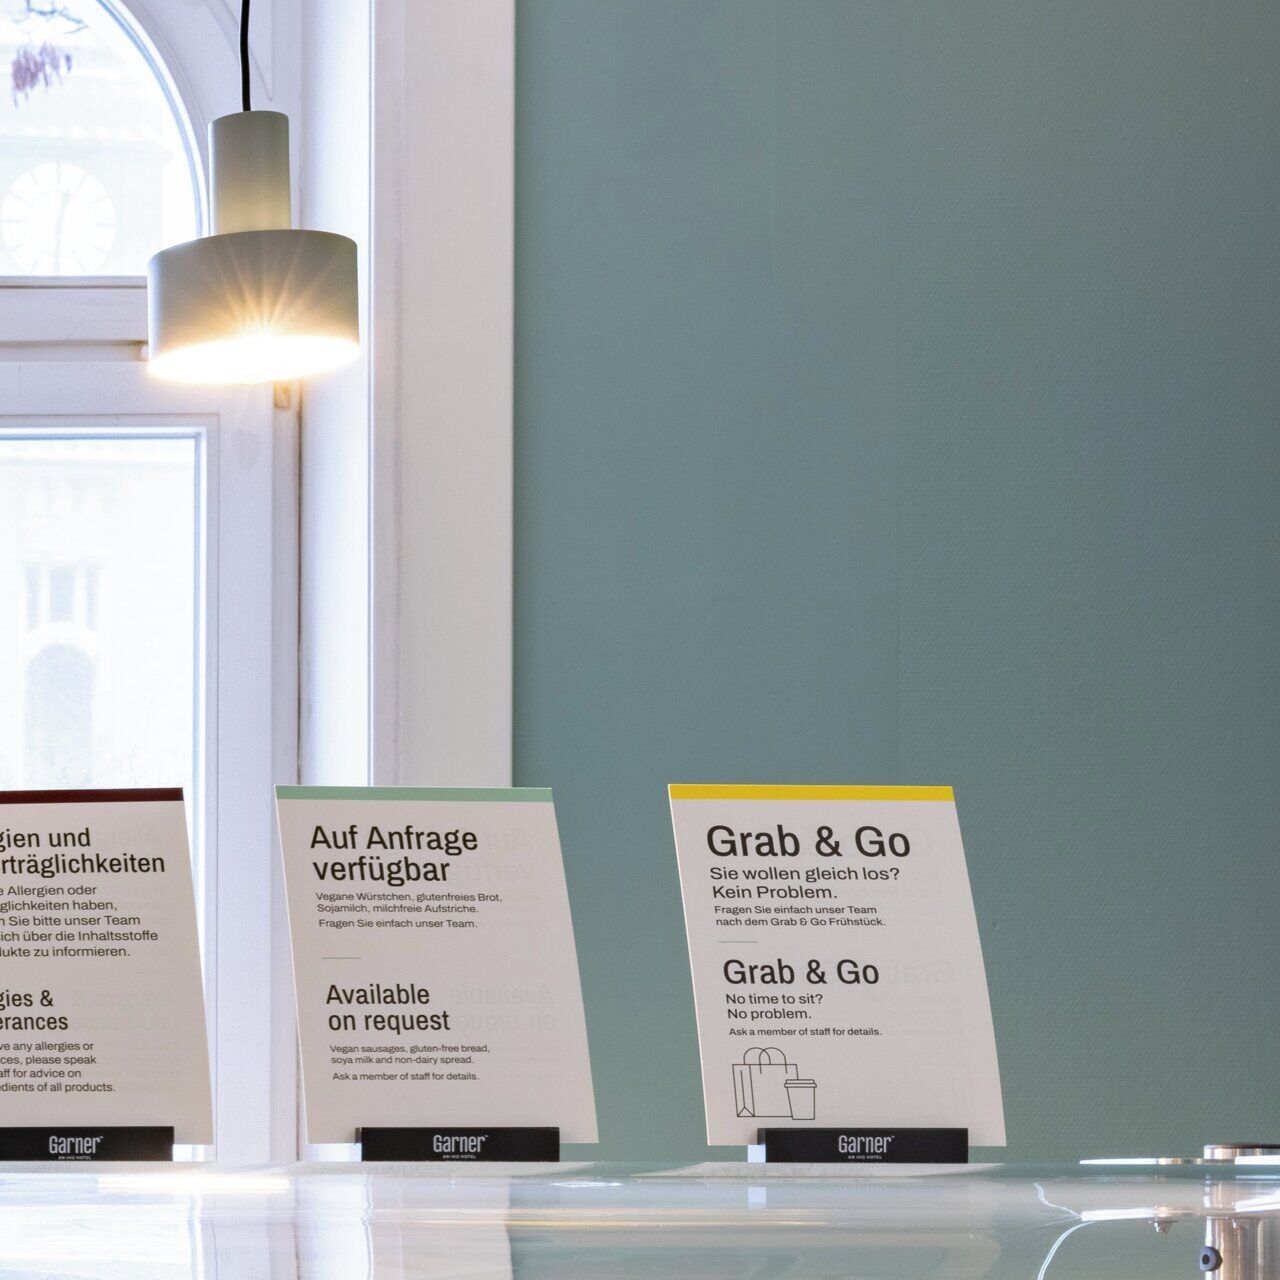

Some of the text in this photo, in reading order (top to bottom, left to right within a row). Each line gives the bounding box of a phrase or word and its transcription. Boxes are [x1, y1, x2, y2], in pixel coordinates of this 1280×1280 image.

[48, 827, 91, 848] und
[310, 824, 478, 856] Auf Anfrage
[707, 824, 910, 858] Grab & Go
[312, 856, 450, 887] verfügbar
[7, 885, 65, 898] Allergien
[67, 884, 97, 896] oder
[712, 885, 837, 899] Kein Problem.
[723, 958, 879, 984] Grab & Go
[40, 989, 54, 1007] &
[326, 983, 430, 1005] Available
[726, 993, 823, 1004] No time to sit?
[328, 1010, 450, 1035] on request
[48, 1135, 100, 1155] Garner
[433, 1134, 485, 1153] Garner
[838, 1134, 892, 1154] Garner
